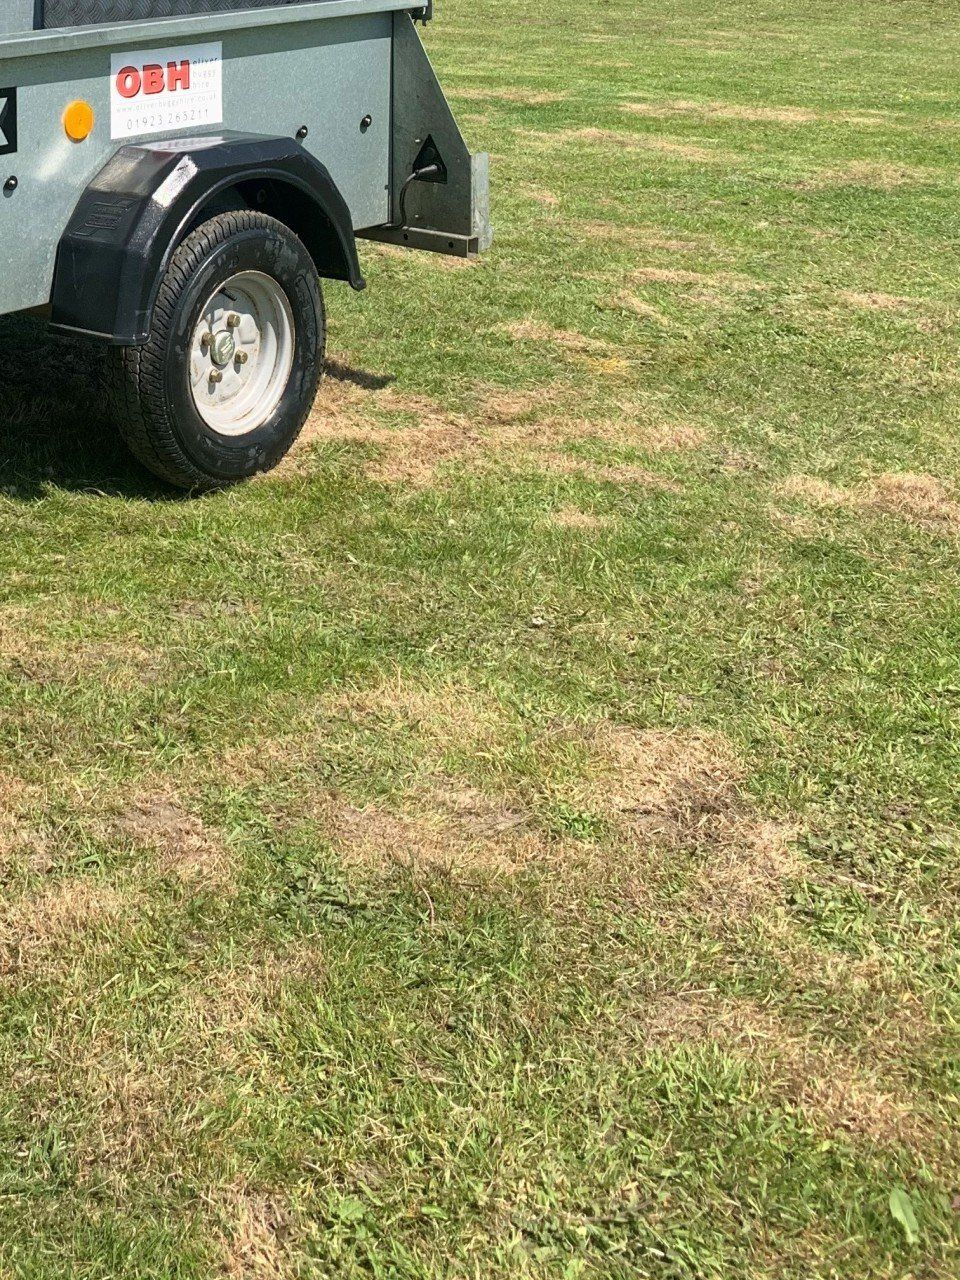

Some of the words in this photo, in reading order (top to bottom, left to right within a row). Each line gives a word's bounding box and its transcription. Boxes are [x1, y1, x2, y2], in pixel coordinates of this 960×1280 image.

[192, 56, 218, 65] oliver
[116, 59, 191, 98] OBH
[127, 113, 163, 130] 01923
